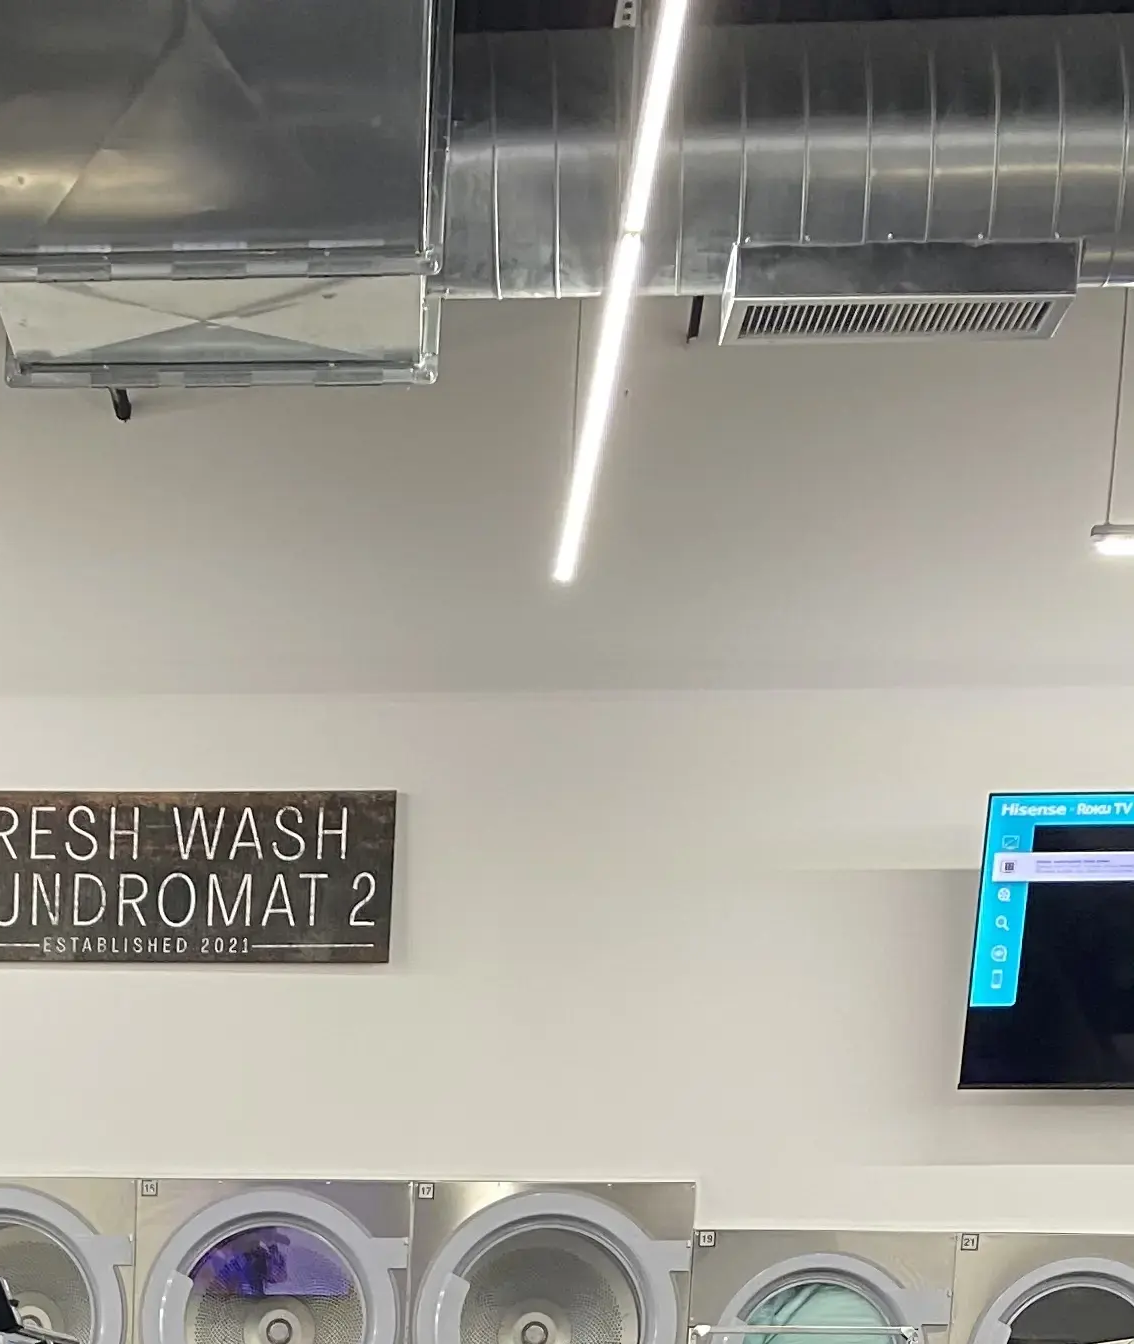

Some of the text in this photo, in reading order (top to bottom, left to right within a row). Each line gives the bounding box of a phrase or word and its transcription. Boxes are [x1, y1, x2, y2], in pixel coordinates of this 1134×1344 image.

[1000, 802, 1133, 817] Hisense Roku TV
[172, 805, 349, 862] WASH
[348, 871, 378, 928] 2
[42, 936, 252, 954] ESTABLISHED 2021
[421, 1186, 432, 1196] 17
[702, 1234, 713, 1244] 19
[963, 1238, 975, 1247] 21
